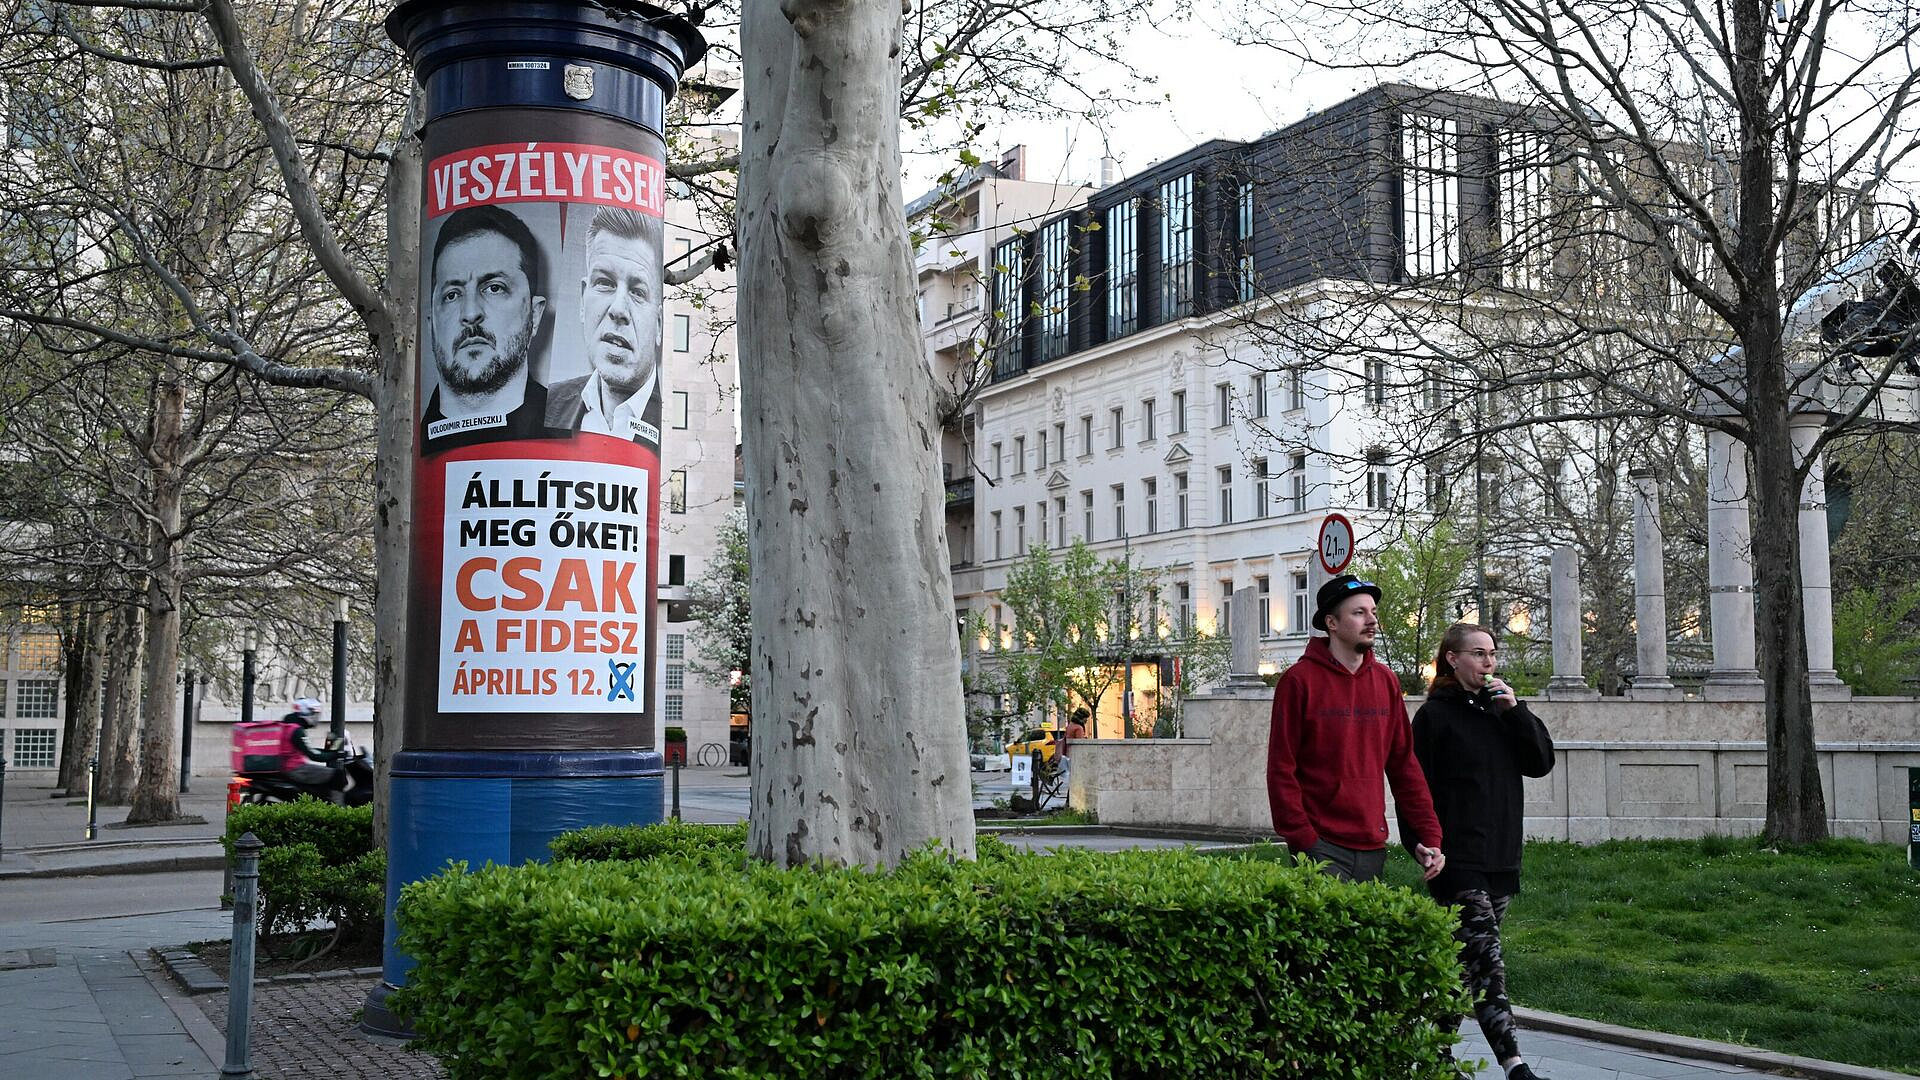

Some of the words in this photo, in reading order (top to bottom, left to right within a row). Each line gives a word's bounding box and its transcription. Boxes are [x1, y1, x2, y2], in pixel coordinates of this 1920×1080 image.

[433, 142, 664, 215] VESZÉLYESEK!
[430, 420, 460, 435] VOLODIMIR
[461, 414, 502, 428] ZELENSZKIJ
[629, 420, 648, 434] MAGYAR
[461, 471, 639, 515] ÁLLÍTSUK
[459, 518, 537, 548] MEG
[549, 511, 638, 553] ŐKET!
[455, 556, 638, 615] CSAK
[453, 619, 484, 653] A
[495, 619, 638, 655] FIDESZ
[452, 660, 558, 696] ÁPRILIS
[566, 668, 603, 696] 12.
